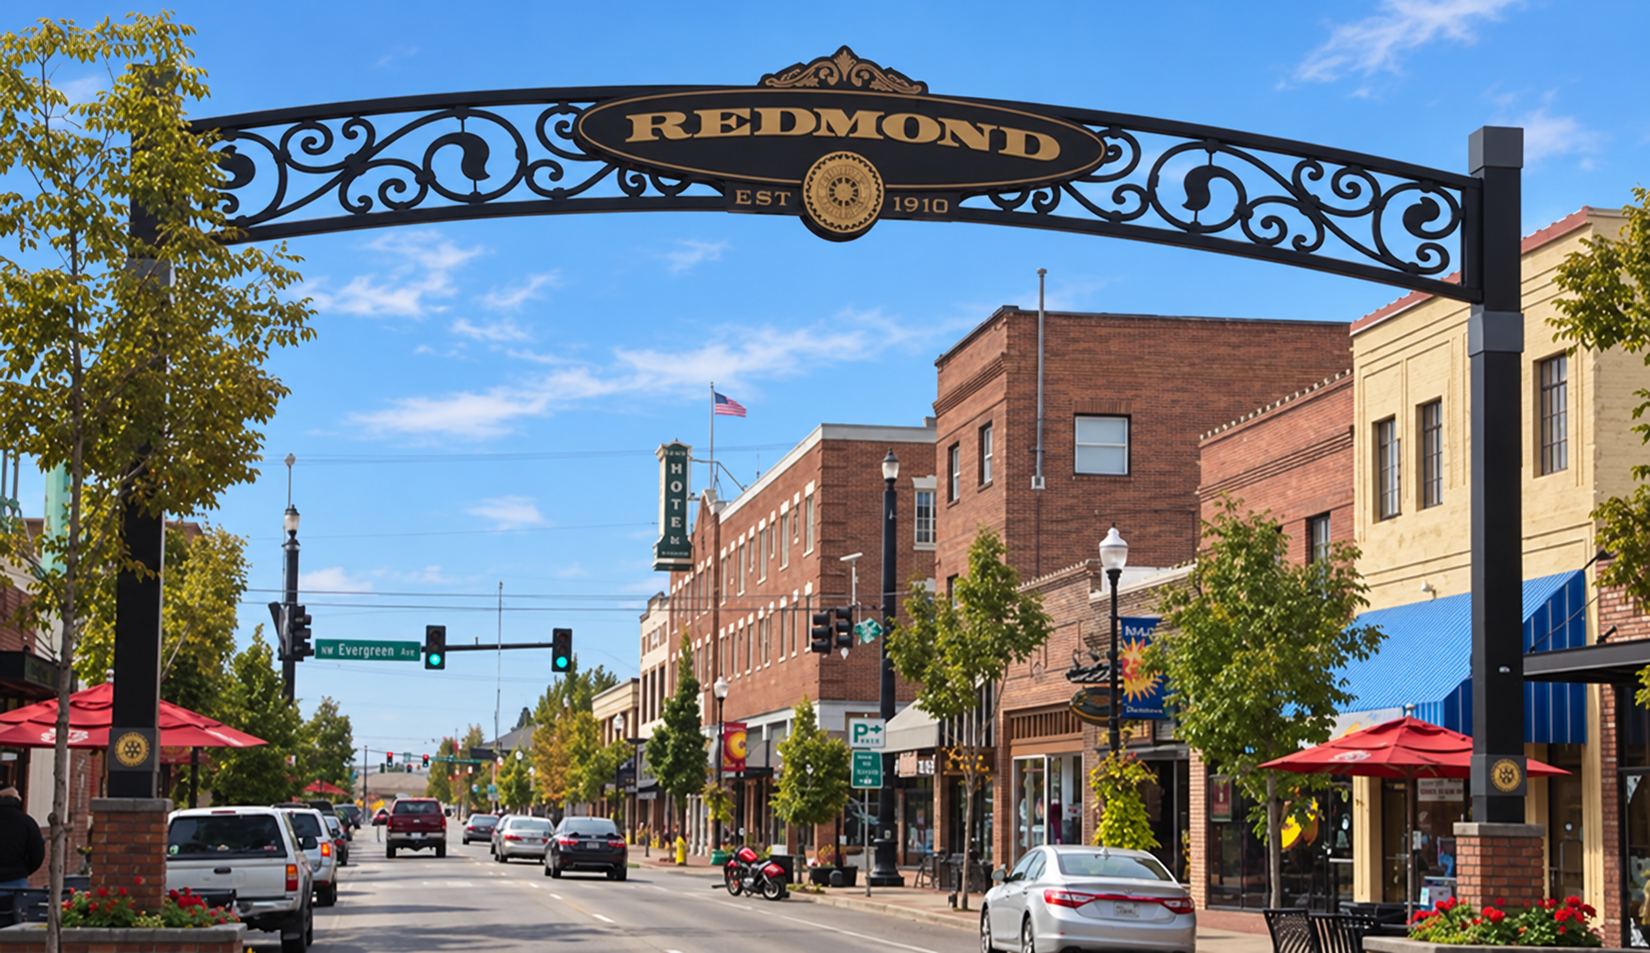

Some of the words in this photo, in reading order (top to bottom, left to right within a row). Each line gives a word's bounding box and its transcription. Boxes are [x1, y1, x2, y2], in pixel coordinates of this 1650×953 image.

[625, 107, 1061, 161] REDMOND
[735, 189, 792, 206] EST
[893, 196, 949, 214] 1910
[321, 646, 334, 655] NW
[338, 643, 394, 659] Evergreen
[400, 647, 415, 657] Ave
[853, 723, 869, 744] P
